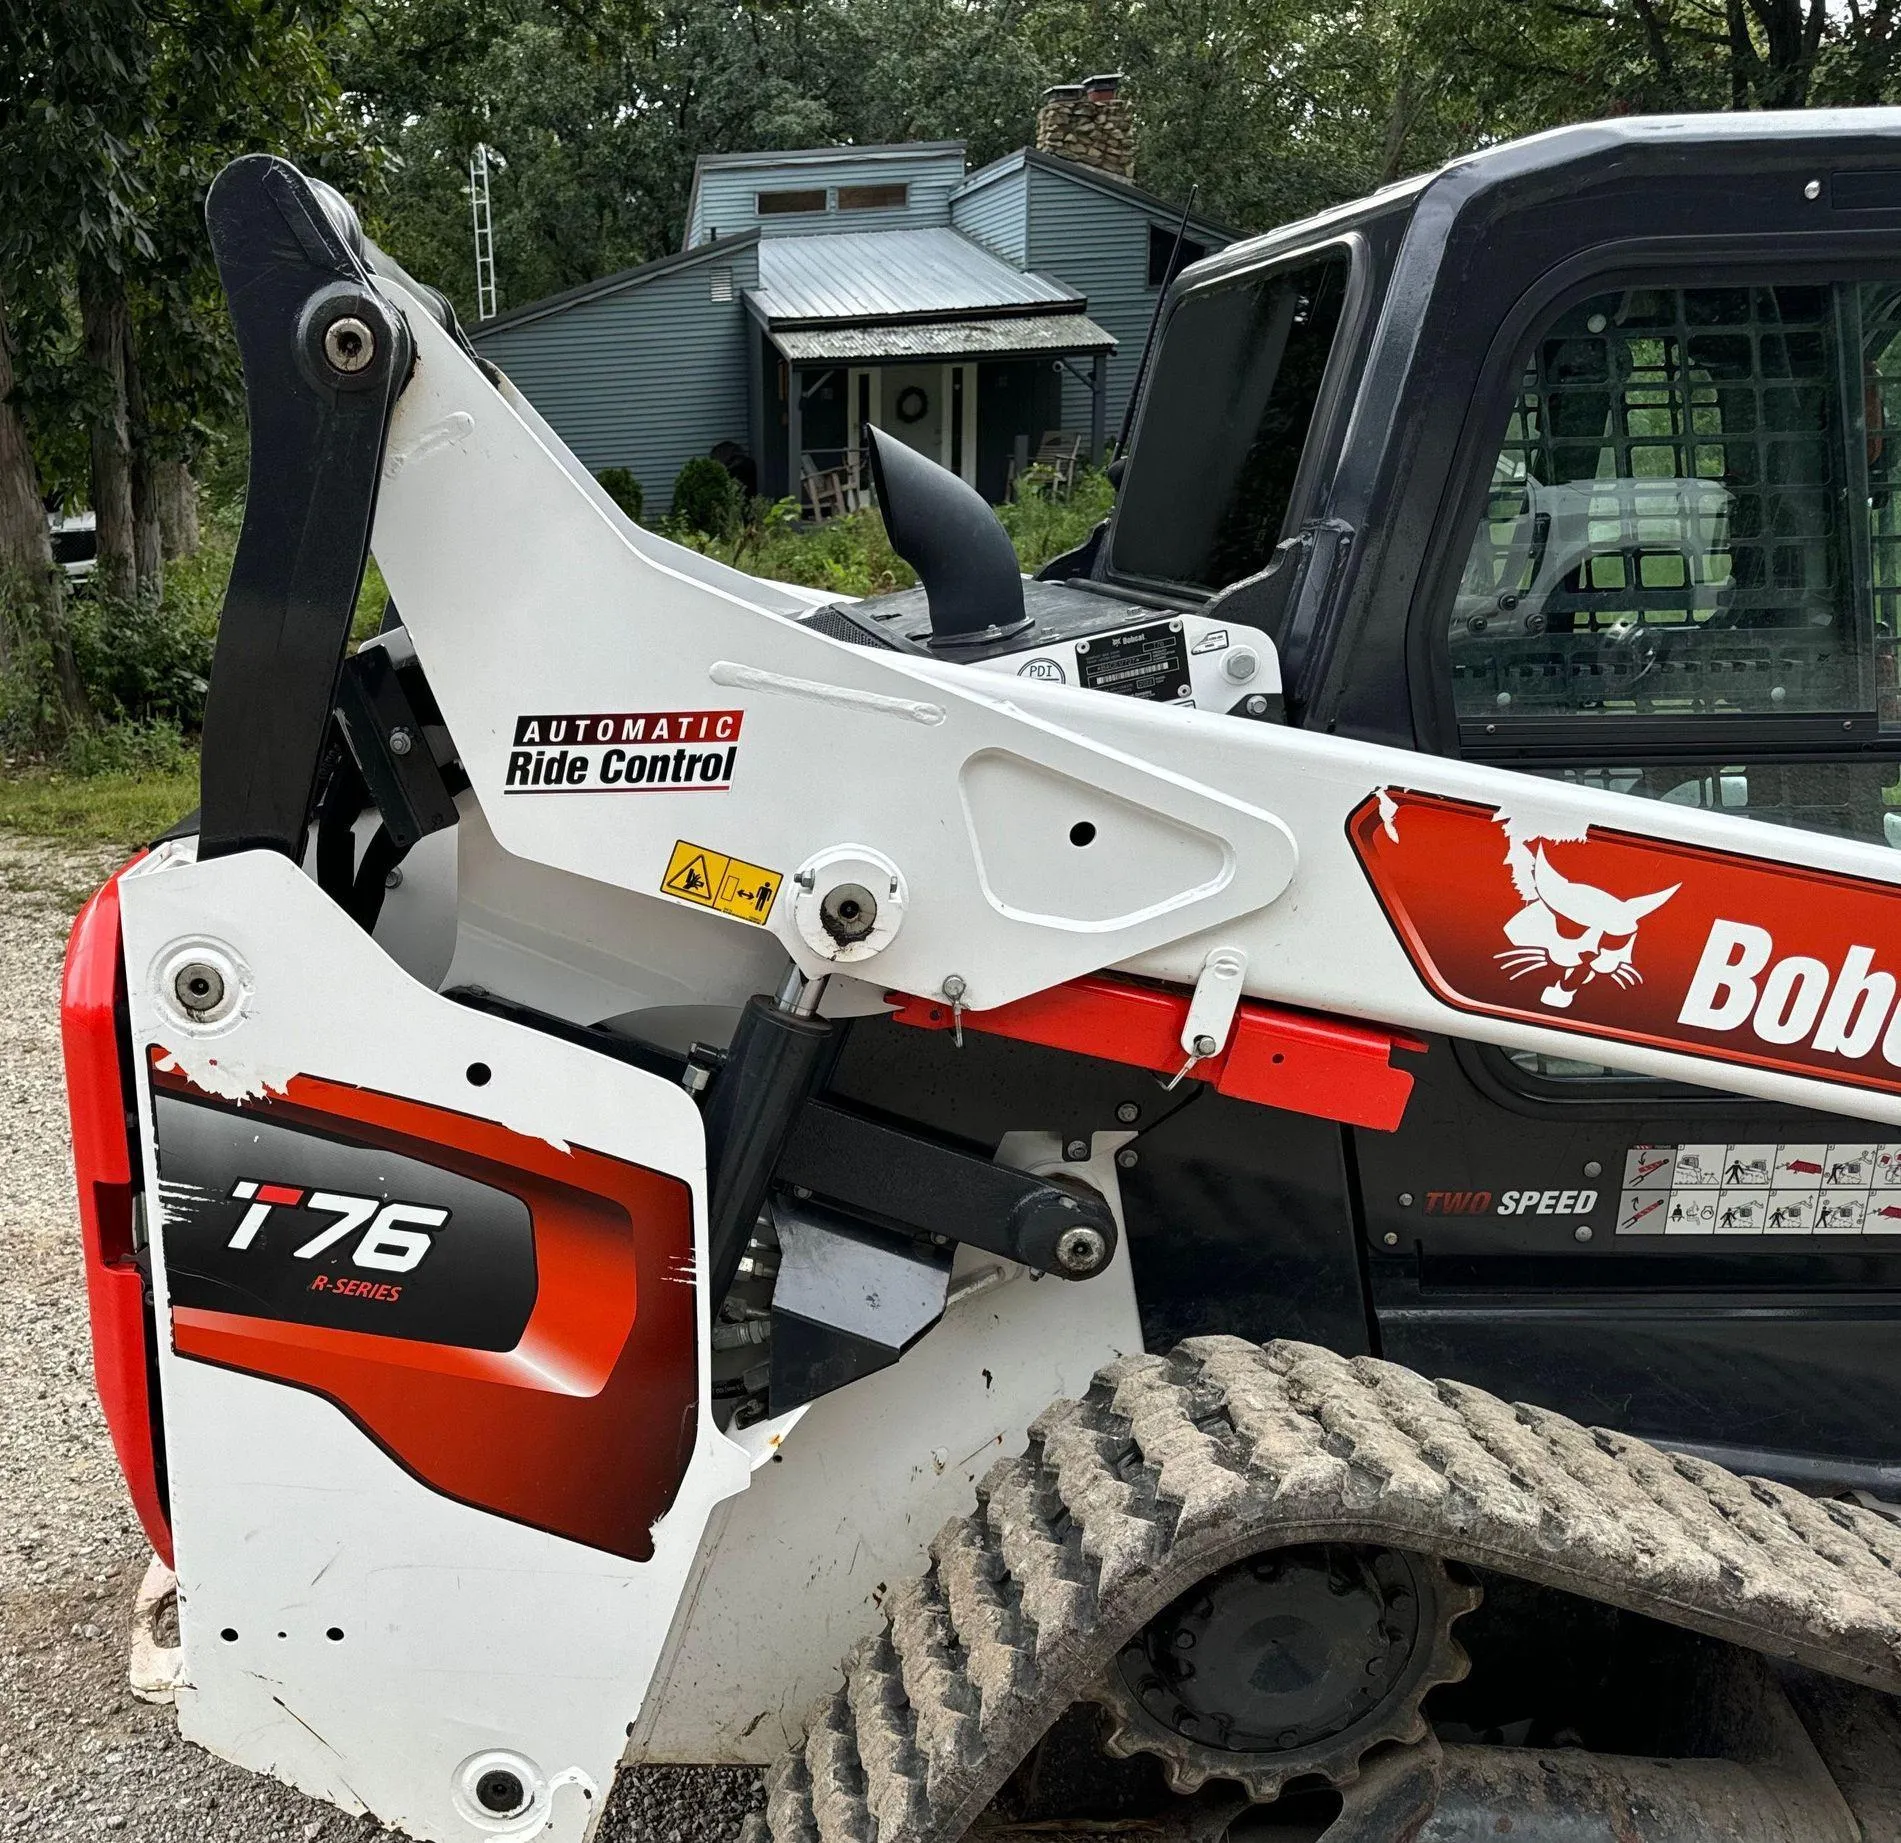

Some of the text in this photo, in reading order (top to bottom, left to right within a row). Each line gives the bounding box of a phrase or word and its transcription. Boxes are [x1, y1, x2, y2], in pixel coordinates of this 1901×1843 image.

[1029, 665, 1053, 678] PDI
[522, 716, 734, 743] AUTOMATIC
[505, 746, 738, 786] Ride Control
[1424, 1190, 1599, 1216] TWO SPEED
[227, 1180, 449, 1273] T76
[311, 1275, 403, 1302] R-SERIES
